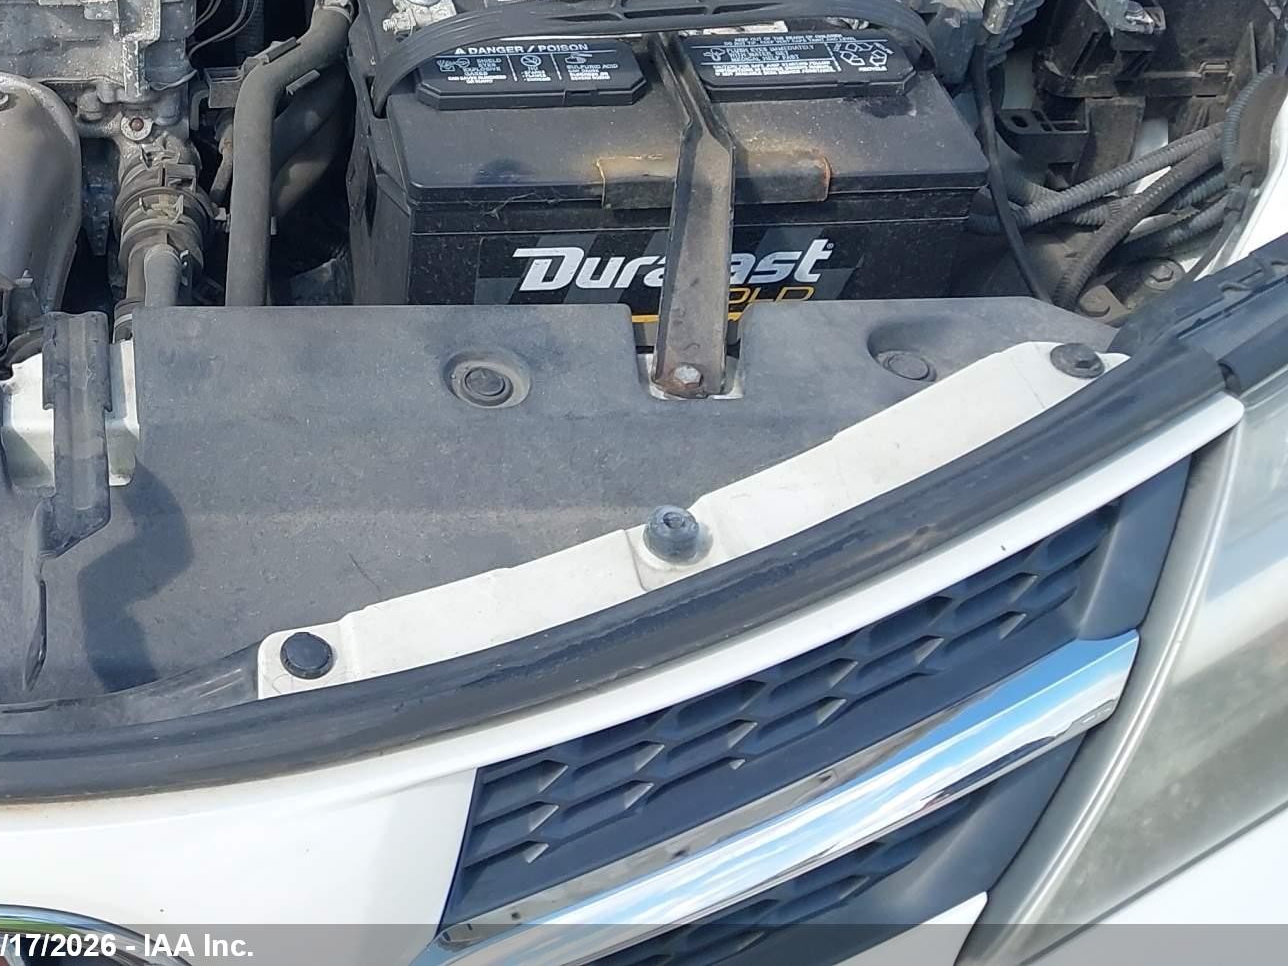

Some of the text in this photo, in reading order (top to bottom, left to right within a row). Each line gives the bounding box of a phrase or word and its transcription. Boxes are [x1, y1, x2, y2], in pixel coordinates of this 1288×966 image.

[468, 43, 589, 55] DANGER / POISON
